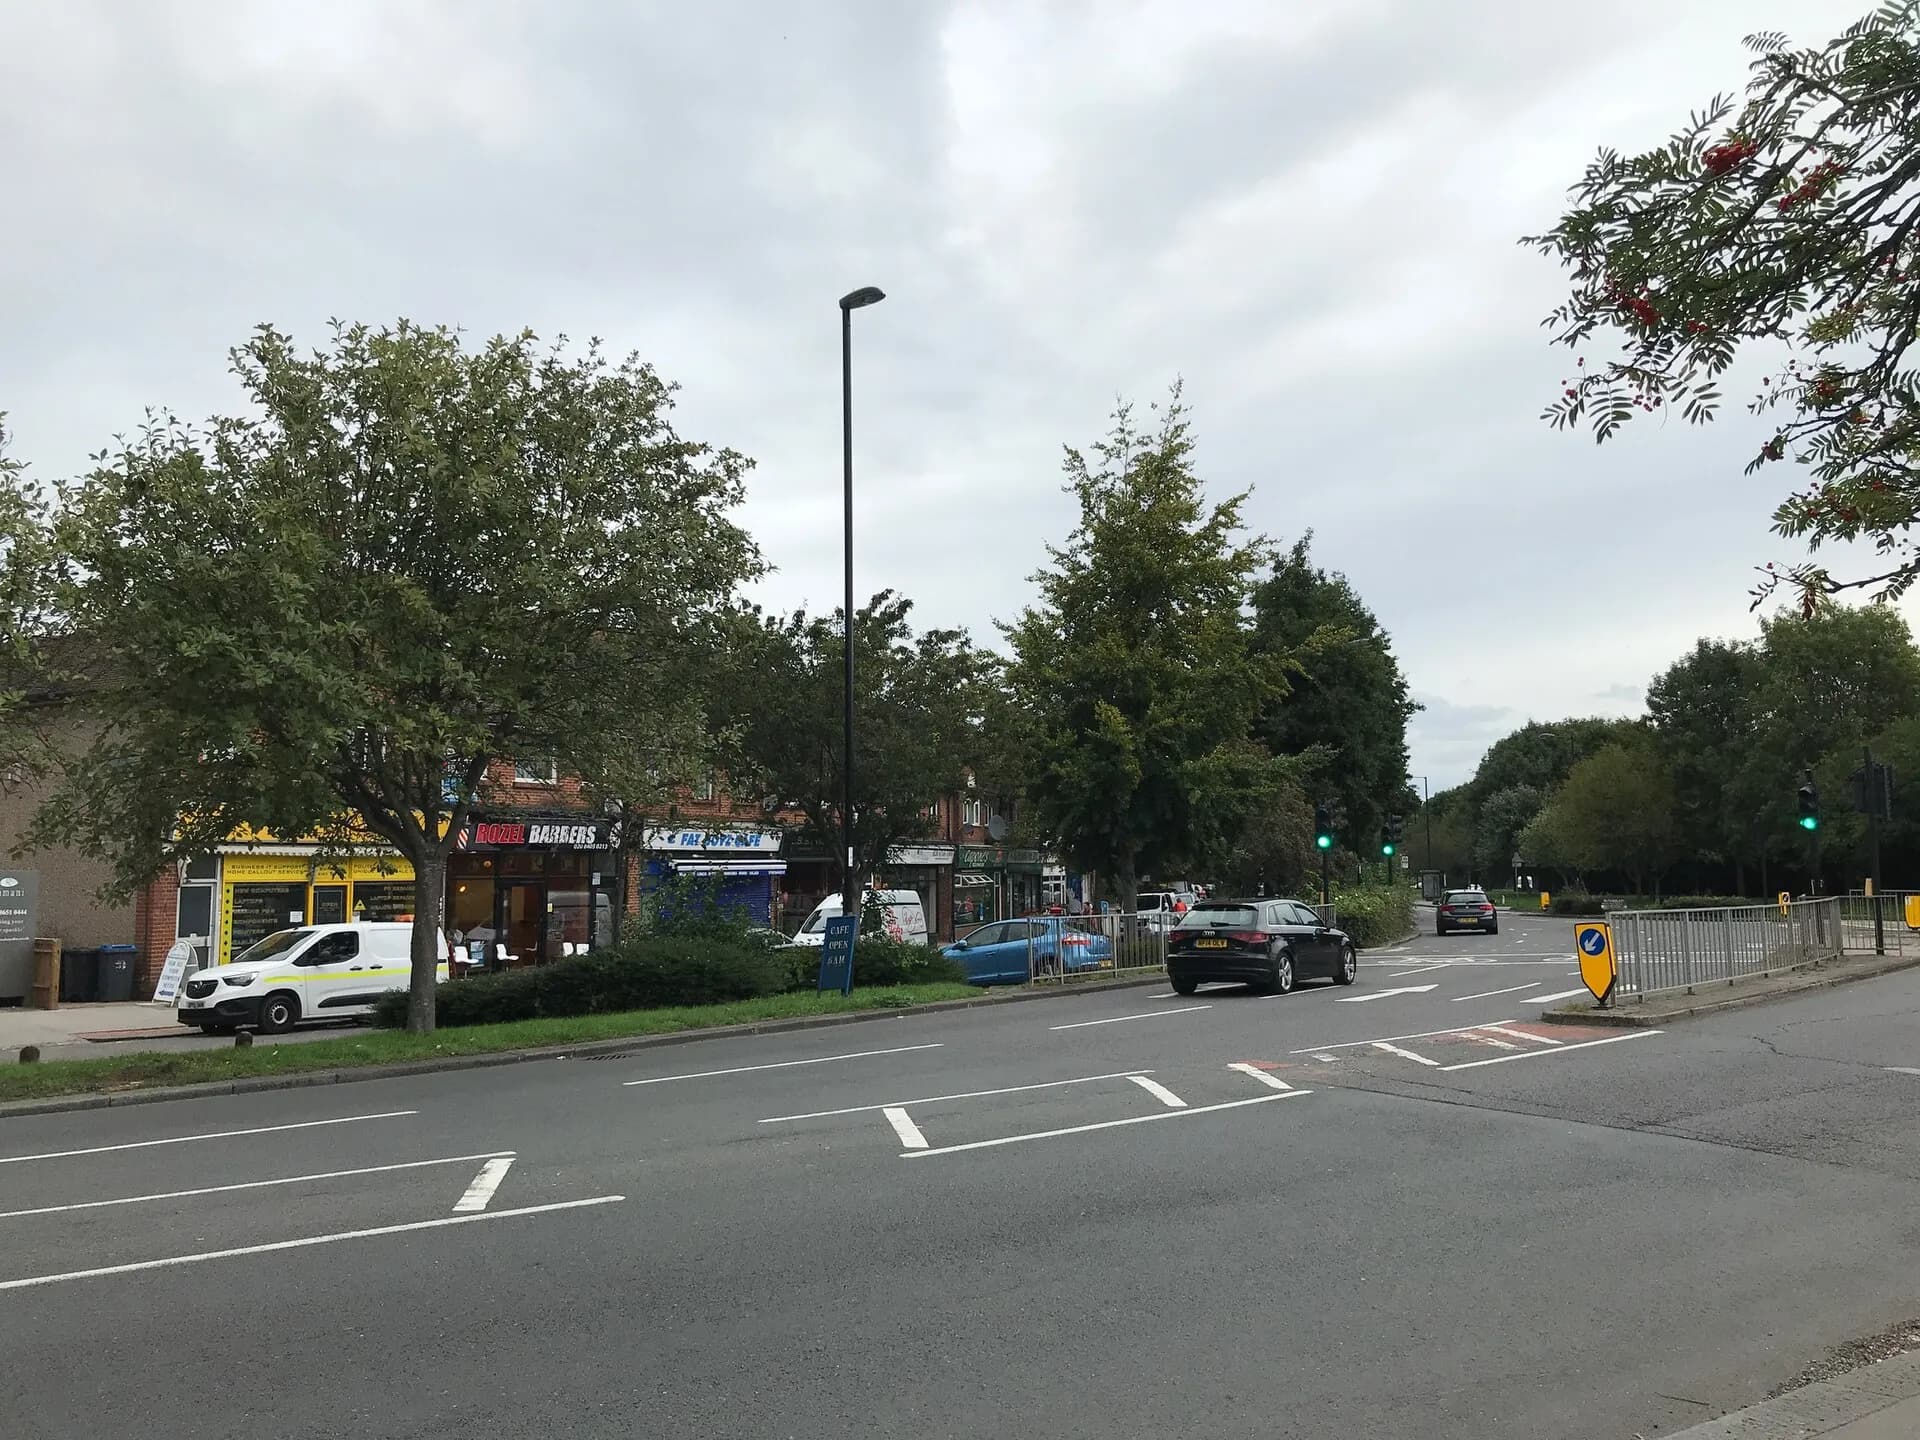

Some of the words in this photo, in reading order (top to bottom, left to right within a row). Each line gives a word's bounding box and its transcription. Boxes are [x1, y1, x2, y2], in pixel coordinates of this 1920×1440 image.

[475, 823, 525, 844] ROZEL
[529, 825, 597, 844] BARBERS
[681, 833, 701, 846] FAT
[830, 924, 850, 935] CAFE
[828, 940, 849, 950] OPEN
